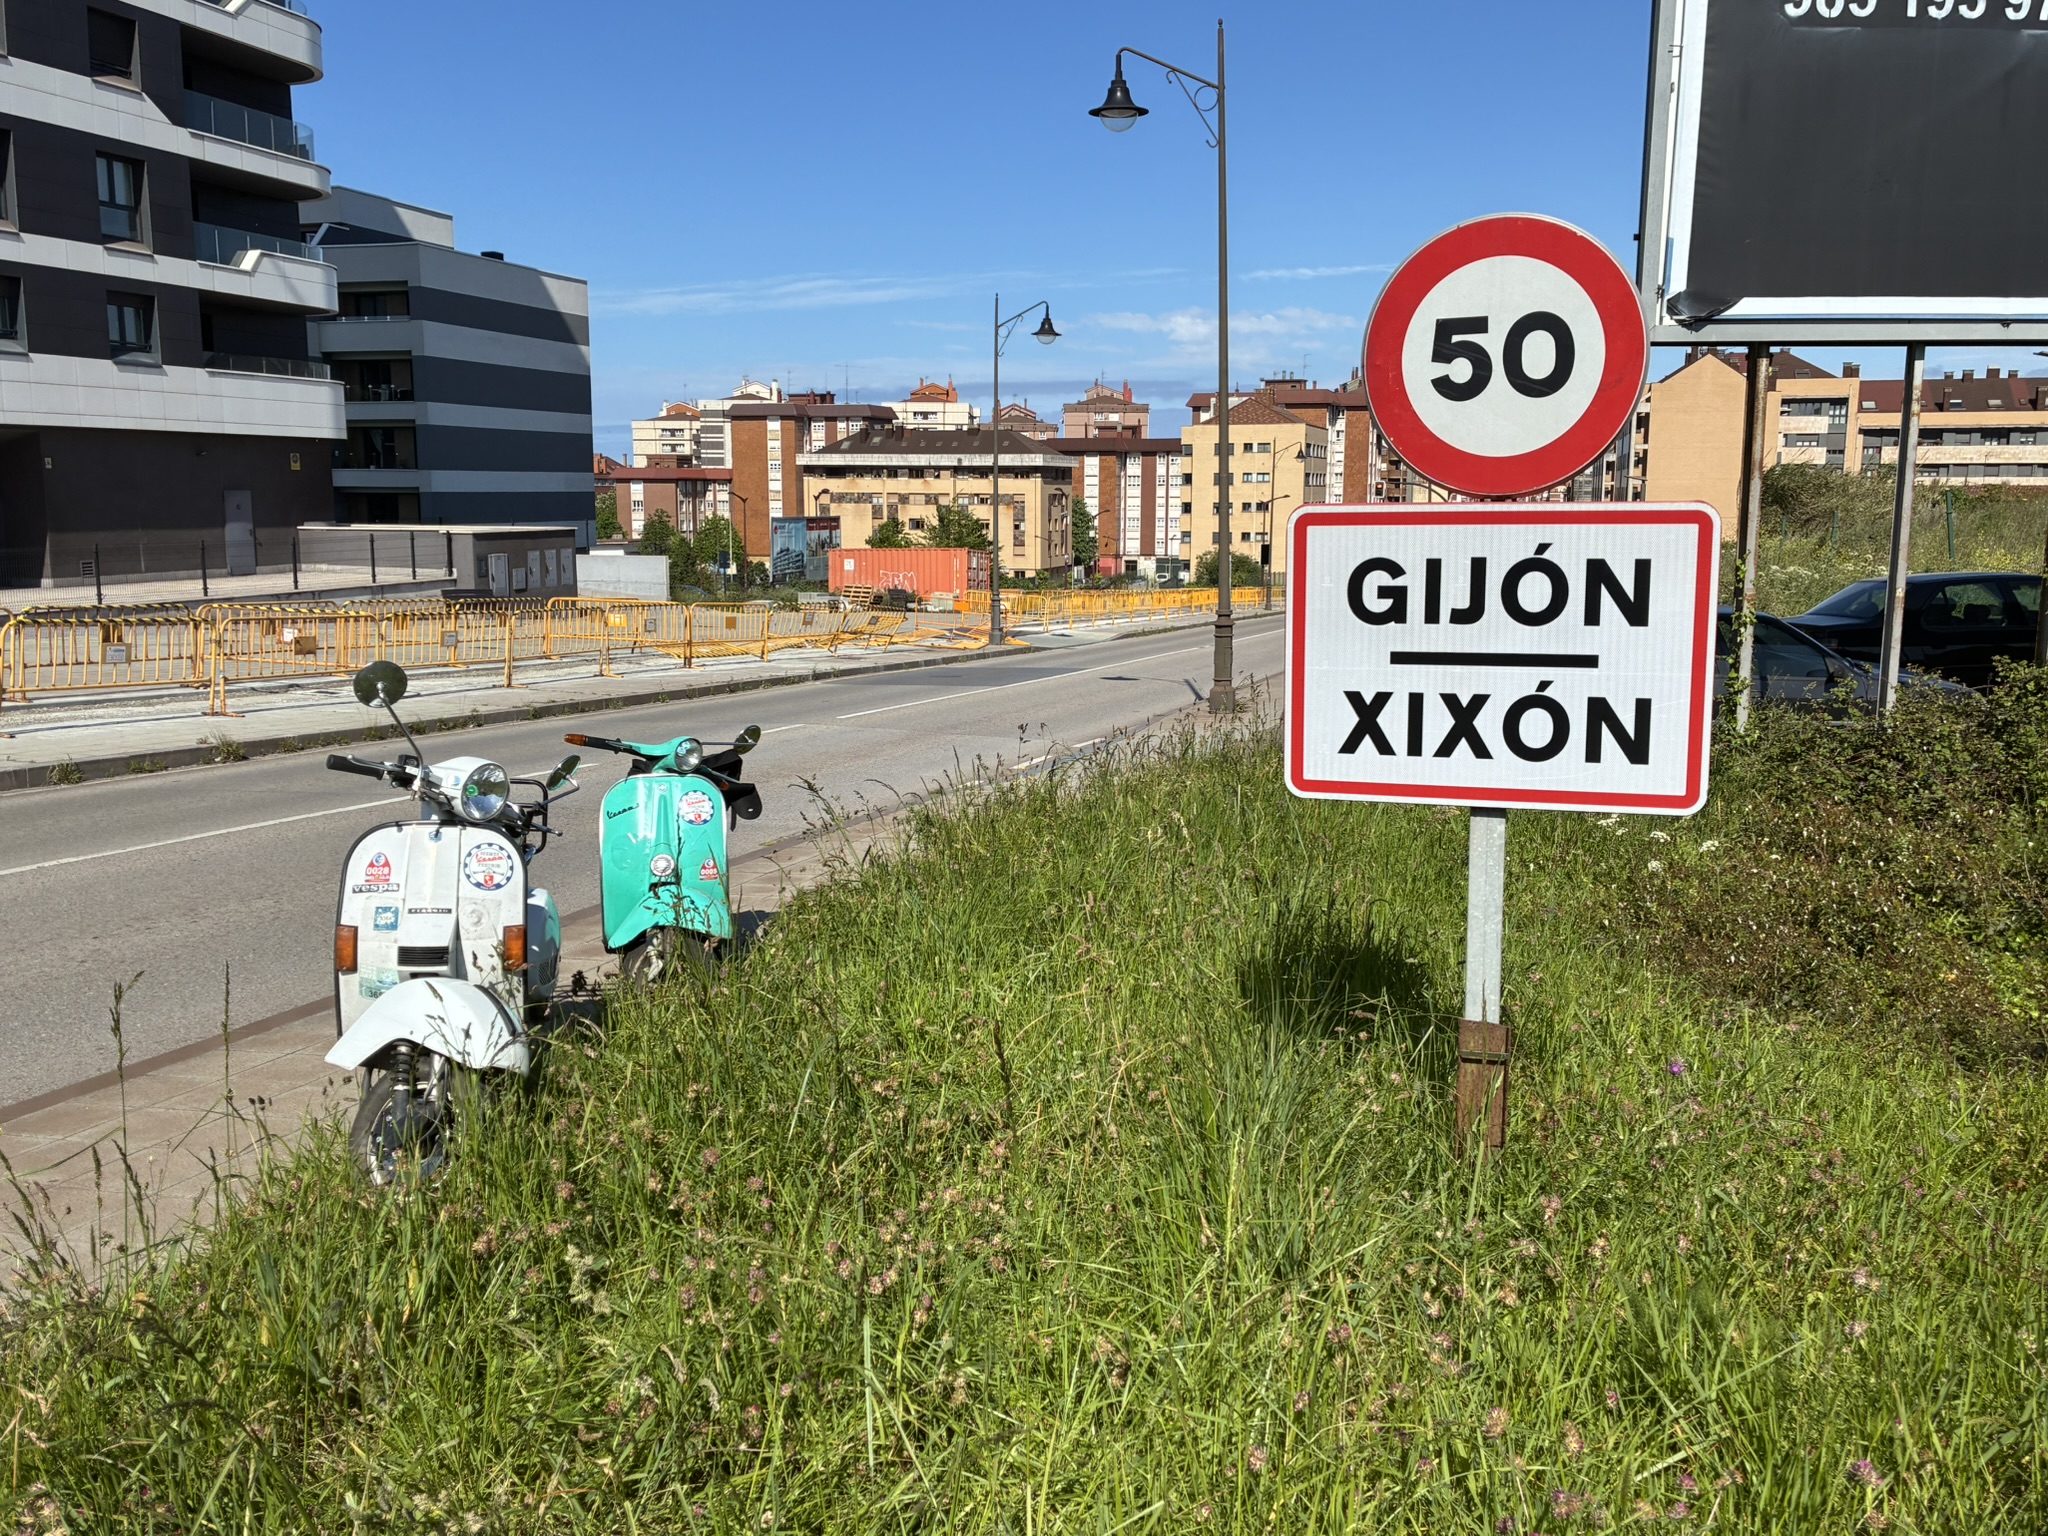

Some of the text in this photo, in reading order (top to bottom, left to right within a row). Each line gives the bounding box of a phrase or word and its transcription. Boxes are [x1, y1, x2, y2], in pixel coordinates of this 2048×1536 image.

[1430, 311, 1576, 402] 50
[1347, 543, 1652, 627] GIJÓN
[1338, 680, 1652, 765] XIXÓN
[353, 884, 399, 894] vespa
[366, 866, 389, 875] 0028
